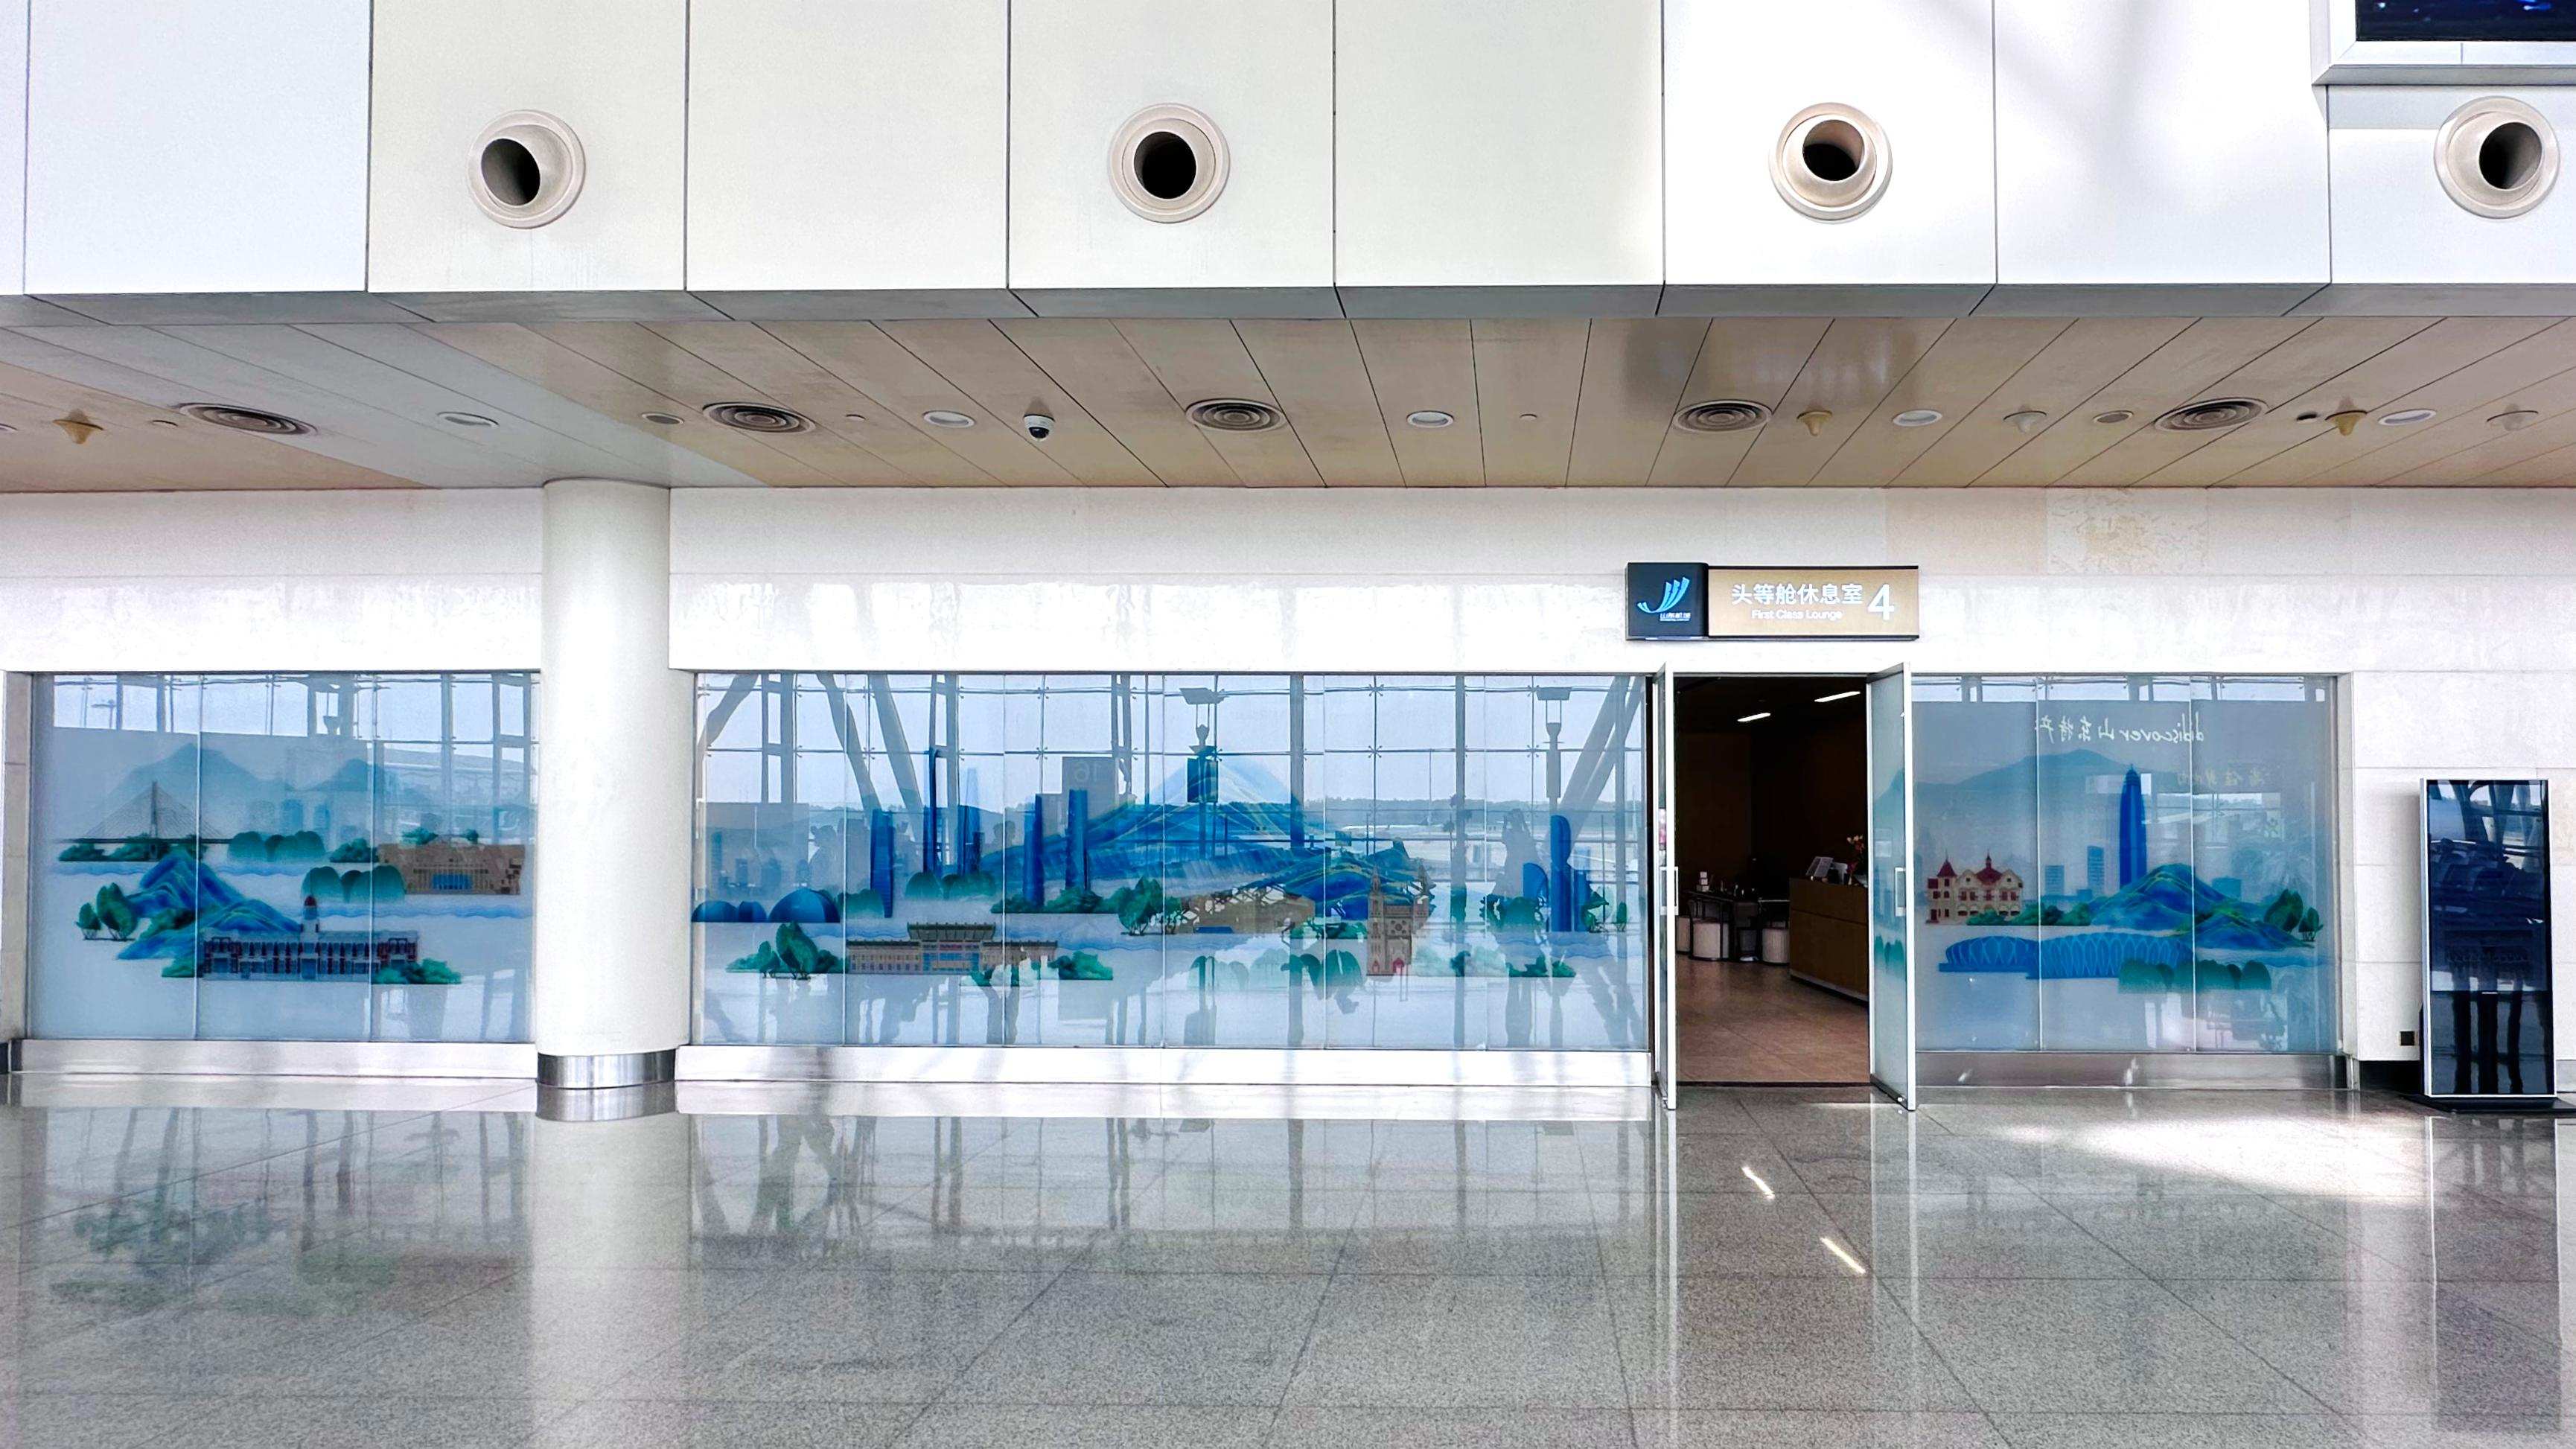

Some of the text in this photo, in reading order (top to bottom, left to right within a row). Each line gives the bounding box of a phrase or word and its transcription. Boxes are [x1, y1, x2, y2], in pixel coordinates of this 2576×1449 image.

[1732, 583, 1864, 605] 头等舱休息室
[1866, 584, 1895, 621] 4
[1751, 610, 1843, 621] First Class Lounge
